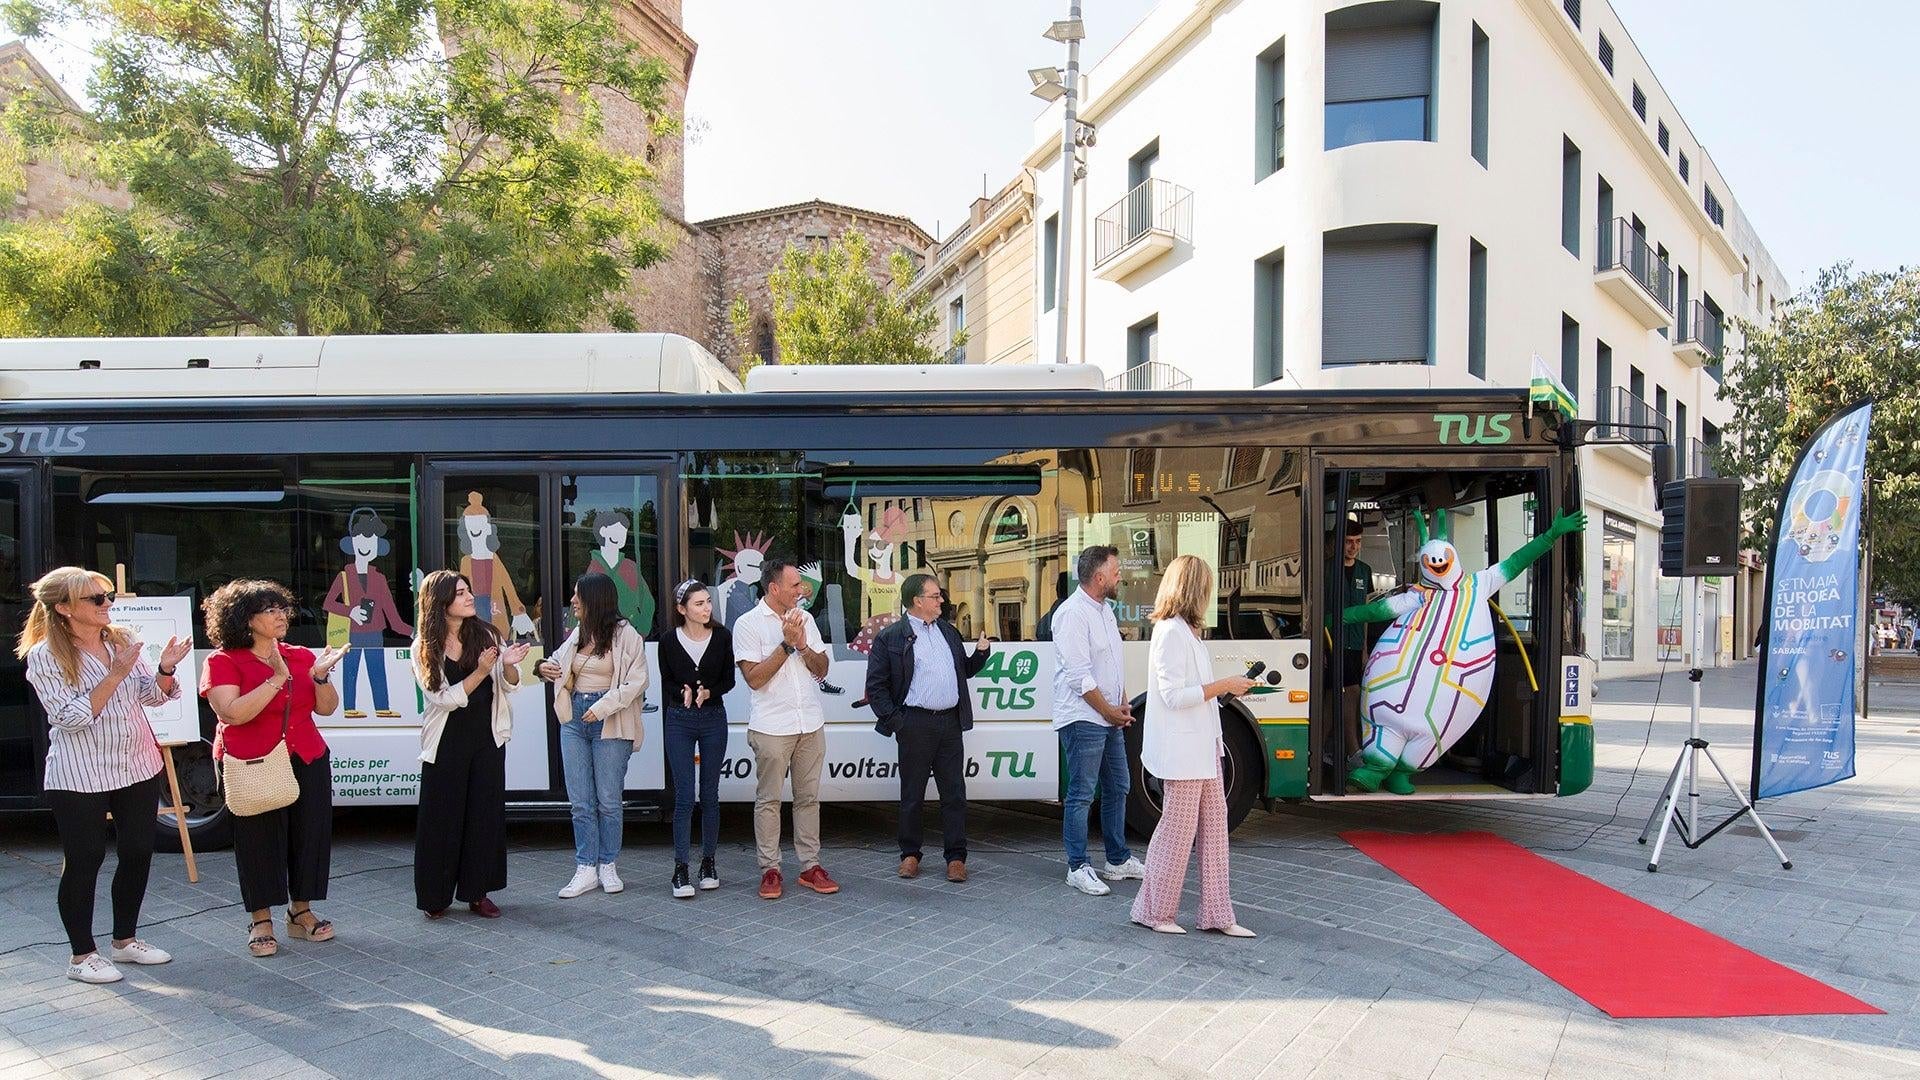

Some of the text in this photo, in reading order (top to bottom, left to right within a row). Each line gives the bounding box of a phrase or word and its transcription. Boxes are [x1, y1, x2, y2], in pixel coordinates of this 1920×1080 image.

[1433, 414, 1512, 444] TUS
[1134, 473, 1210, 491] T.U.S.
[1774, 605, 1816, 618] DE LA
[974, 650, 1039, 684] 40
[976, 687, 1036, 710] TUS
[1823, 751, 1840, 759] TUS
[369, 759, 390, 770] per
[720, 758, 751, 779] 40
[986, 751, 1037, 778] TU
[331, 773, 422, 785] ompanyar-nos
[340, 786, 381, 798] aquest
[386, 785, 417, 796] camí
